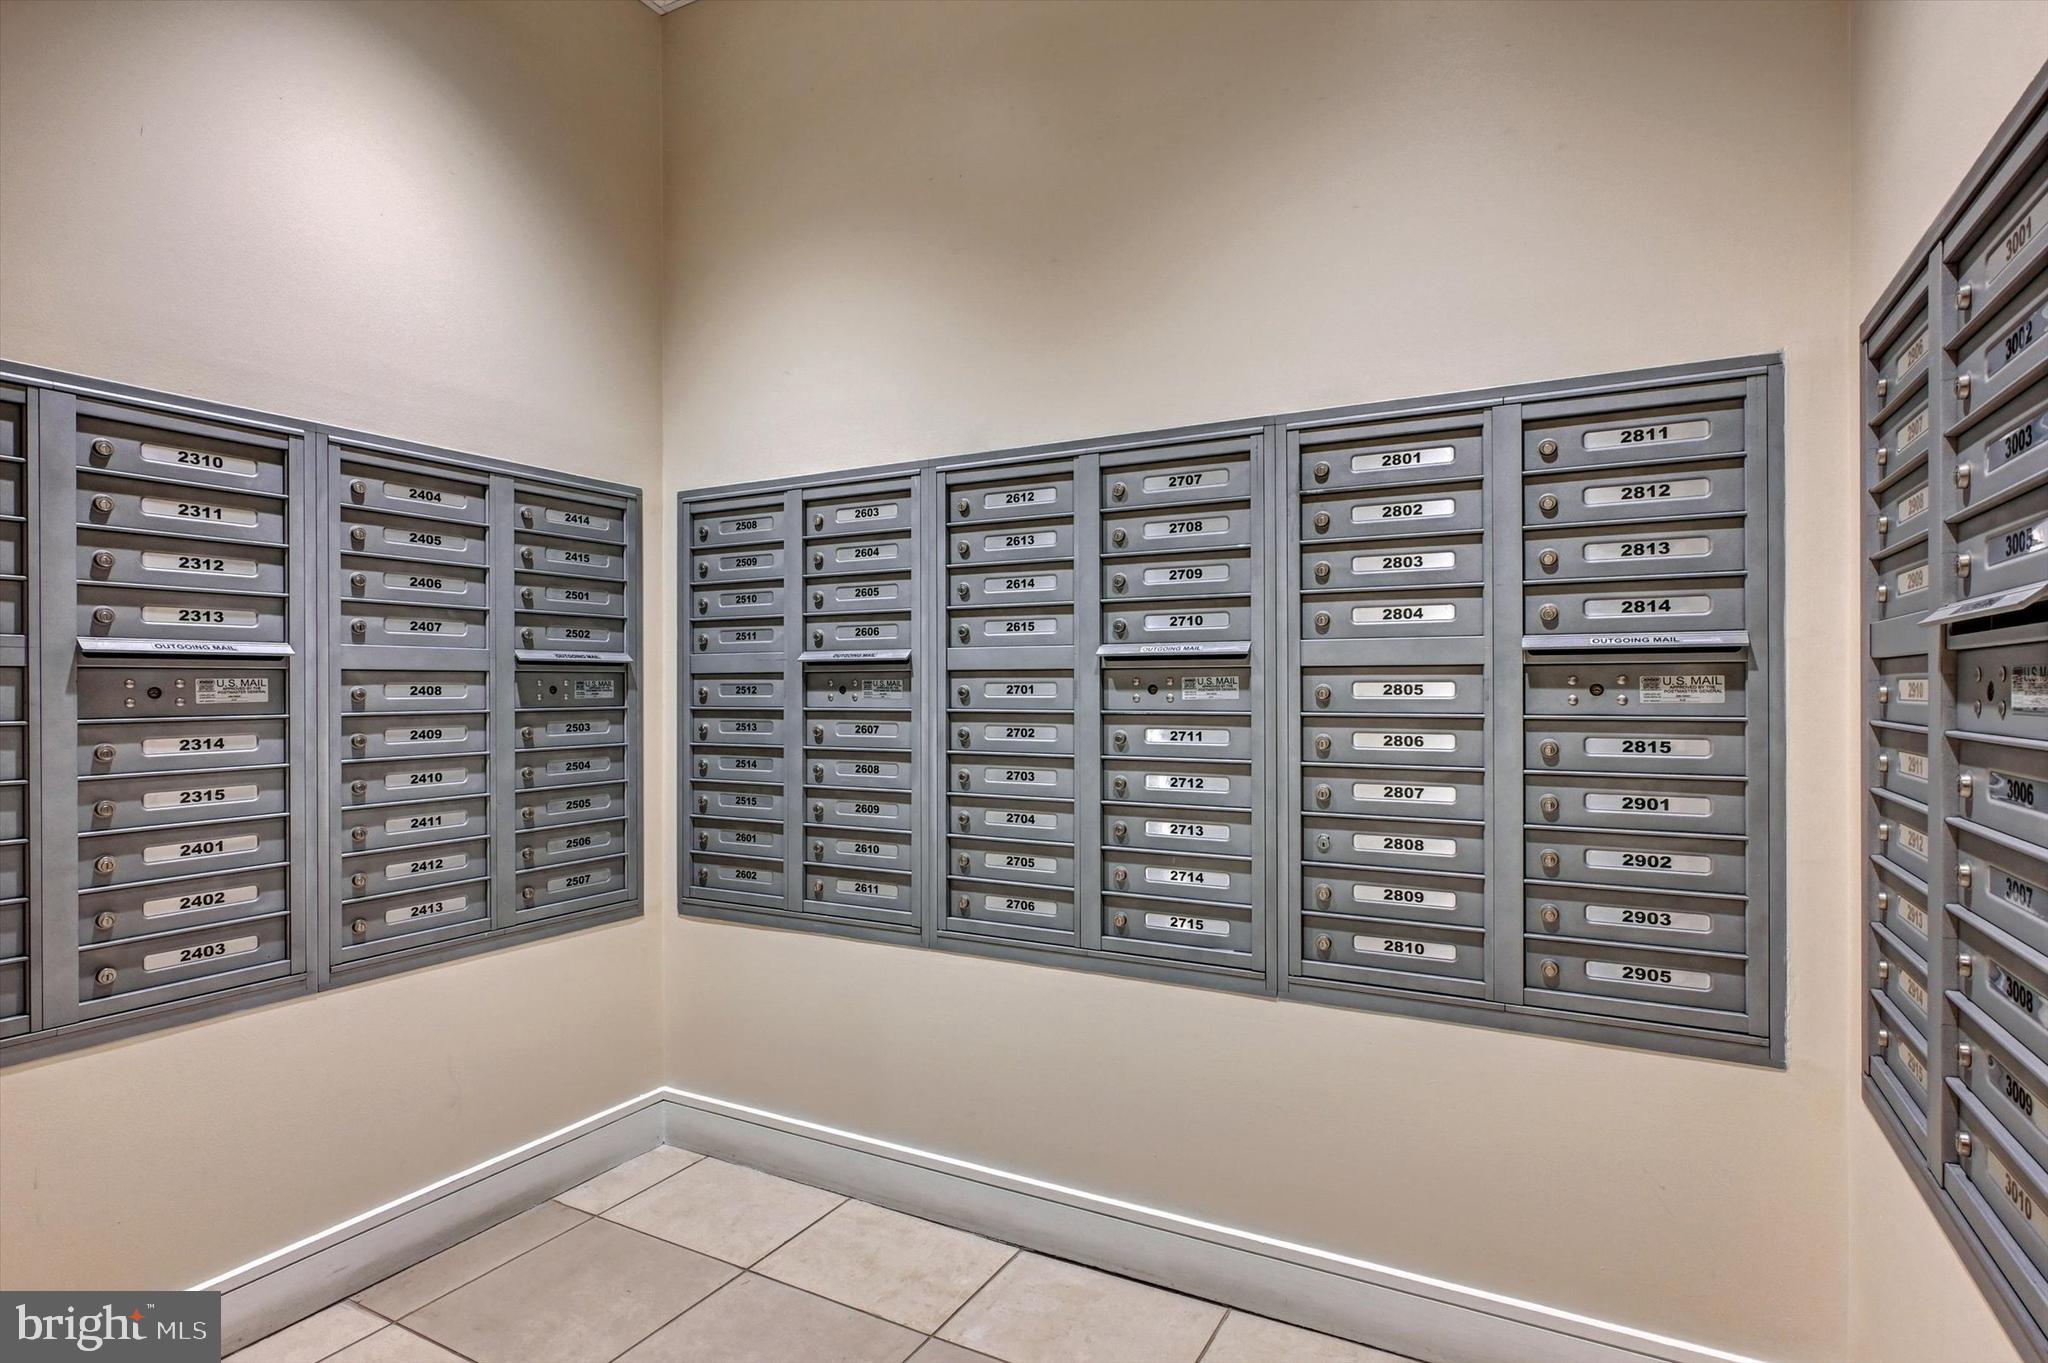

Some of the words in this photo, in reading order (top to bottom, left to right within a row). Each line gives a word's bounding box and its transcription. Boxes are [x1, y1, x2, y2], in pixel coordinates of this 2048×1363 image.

[2005, 216, 2032, 261] 3001
[2005, 320, 2033, 361] 3002
[1620, 426, 1668, 444] 2811
[2005, 424, 2033, 459] 3003
[177, 450, 224, 469] 2310
[1381, 451, 1421, 467] 2801
[1168, 473, 1203, 488] 2707
[408, 488, 442, 503] 2404
[1005, 491, 1035, 504] 2612
[1620, 483, 1671, 500] 2812
[177, 503, 222, 520] 2311
[854, 507, 880, 519] 2603
[1382, 503, 1423, 518] 2802
[564, 513, 590, 526] 2414
[735, 520, 758, 531] 2508
[1169, 520, 1203, 534] 2708
[409, 532, 442, 546] 2405
[1006, 534, 1035, 547] 2613
[2005, 527, 2034, 557] 3005
[854, 547, 880, 558] 2604
[1620, 541, 1671, 557] 2813
[564, 551, 590, 563] 2415
[735, 556, 758, 568] 2509
[1382, 555, 1424, 569] 2803
[178, 556, 224, 572] 2312
[1168, 568, 1203, 581] 2709
[409, 576, 442, 589] 2406
[1006, 578, 1035, 590] 2614
[564, 590, 590, 601] 2501
[735, 594, 758, 604] 2510
[855, 587, 880, 598] 2605
[1621, 599, 1672, 614] 2814
[178, 609, 224, 623] 2313
[1382, 607, 1424, 620] 2804
[409, 620, 442, 633] 2407
[1006, 621, 1035, 632] 2615
[1169, 615, 1204, 627] 2710
[565, 628, 591, 639] 2502
[735, 631, 757, 641] 2511
[855, 626, 880, 637] 2606
[153, 643, 211, 651] OUTGOING
[1591, 637, 1650, 645] OUTGOING
[216, 678, 239, 688] U.S.
[240, 678, 267, 687] MAIL
[1197, 677, 1214, 686] U.S.
[1215, 676, 1238, 685] MAIL
[1662, 676, 1688, 686] U.S.
[1690, 676, 1723, 685] MAIL
[409, 685, 442, 696] 2408
[735, 685, 758, 696] 2512
[1006, 684, 1034, 695] 2701
[1383, 683, 1424, 696] 2805
[1907, 682, 1924, 698] 2910
[565, 722, 591, 733] 2503
[735, 722, 758, 732] 2513
[854, 724, 880, 735] 2607
[1006, 727, 1035, 738] 2702
[410, 729, 443, 741] 2409
[1169, 730, 1202, 742] 2711
[1383, 734, 1424, 748] 2806
[179, 737, 225, 752] 2314
[1622, 740, 1672, 754] 2815
[565, 760, 591, 772] 2504
[735, 759, 758, 769] 2514
[854, 764, 880, 775] 2608
[1907, 756, 1923, 775] 2911
[410, 772, 443, 785] 2410
[1006, 770, 1035, 782] 2703
[1170, 777, 1204, 789] 2712
[179, 788, 226, 804] 2315
[1383, 786, 1425, 799] 2807
[2006, 779, 2034, 806] 3006
[565, 798, 591, 810] 2505
[735, 796, 757, 806] 2515
[1621, 796, 1669, 811] 2901
[855, 803, 880, 815] 2609
[410, 815, 442, 829] 2411
[1006, 812, 1036, 825] 2704
[1170, 823, 1204, 837] 2713
[566, 836, 592, 849] 2506
[735, 832, 756, 843] 2601
[1907, 830, 1924, 852] 2912
[179, 840, 224, 857] 2401
[854, 843, 880, 855] 2610
[1383, 837, 1424, 852] 2808
[410, 858, 444, 873] 2412
[1006, 855, 1035, 868] 2705
[1622, 853, 1672, 869] 2902
[565, 874, 591, 888] 2507
[735, 869, 757, 880] 2602
[1170, 870, 1205, 884] 2714
[854, 882, 879, 895] 2611
[2005, 877, 2034, 908] 3007
[179, 892, 226, 910] 2402
[1383, 888, 1424, 903] 2809
[410, 902, 444, 918] 2413
[1006, 898, 1035, 912] 2706
[1622, 910, 1672, 926] 2903
[1907, 904, 1923, 929] 2913
[1170, 916, 1204, 931] 2715
[180, 943, 226, 963] 2403
[1383, 940, 1425, 955] 2810
[1622, 966, 1672, 984] 2905
[2006, 975, 2034, 1014] 3008
[1907, 1052, 1923, 1082] 2915
[2005, 1074, 2033, 1117] 3009
[2005, 1172, 2032, 1220] 3010
